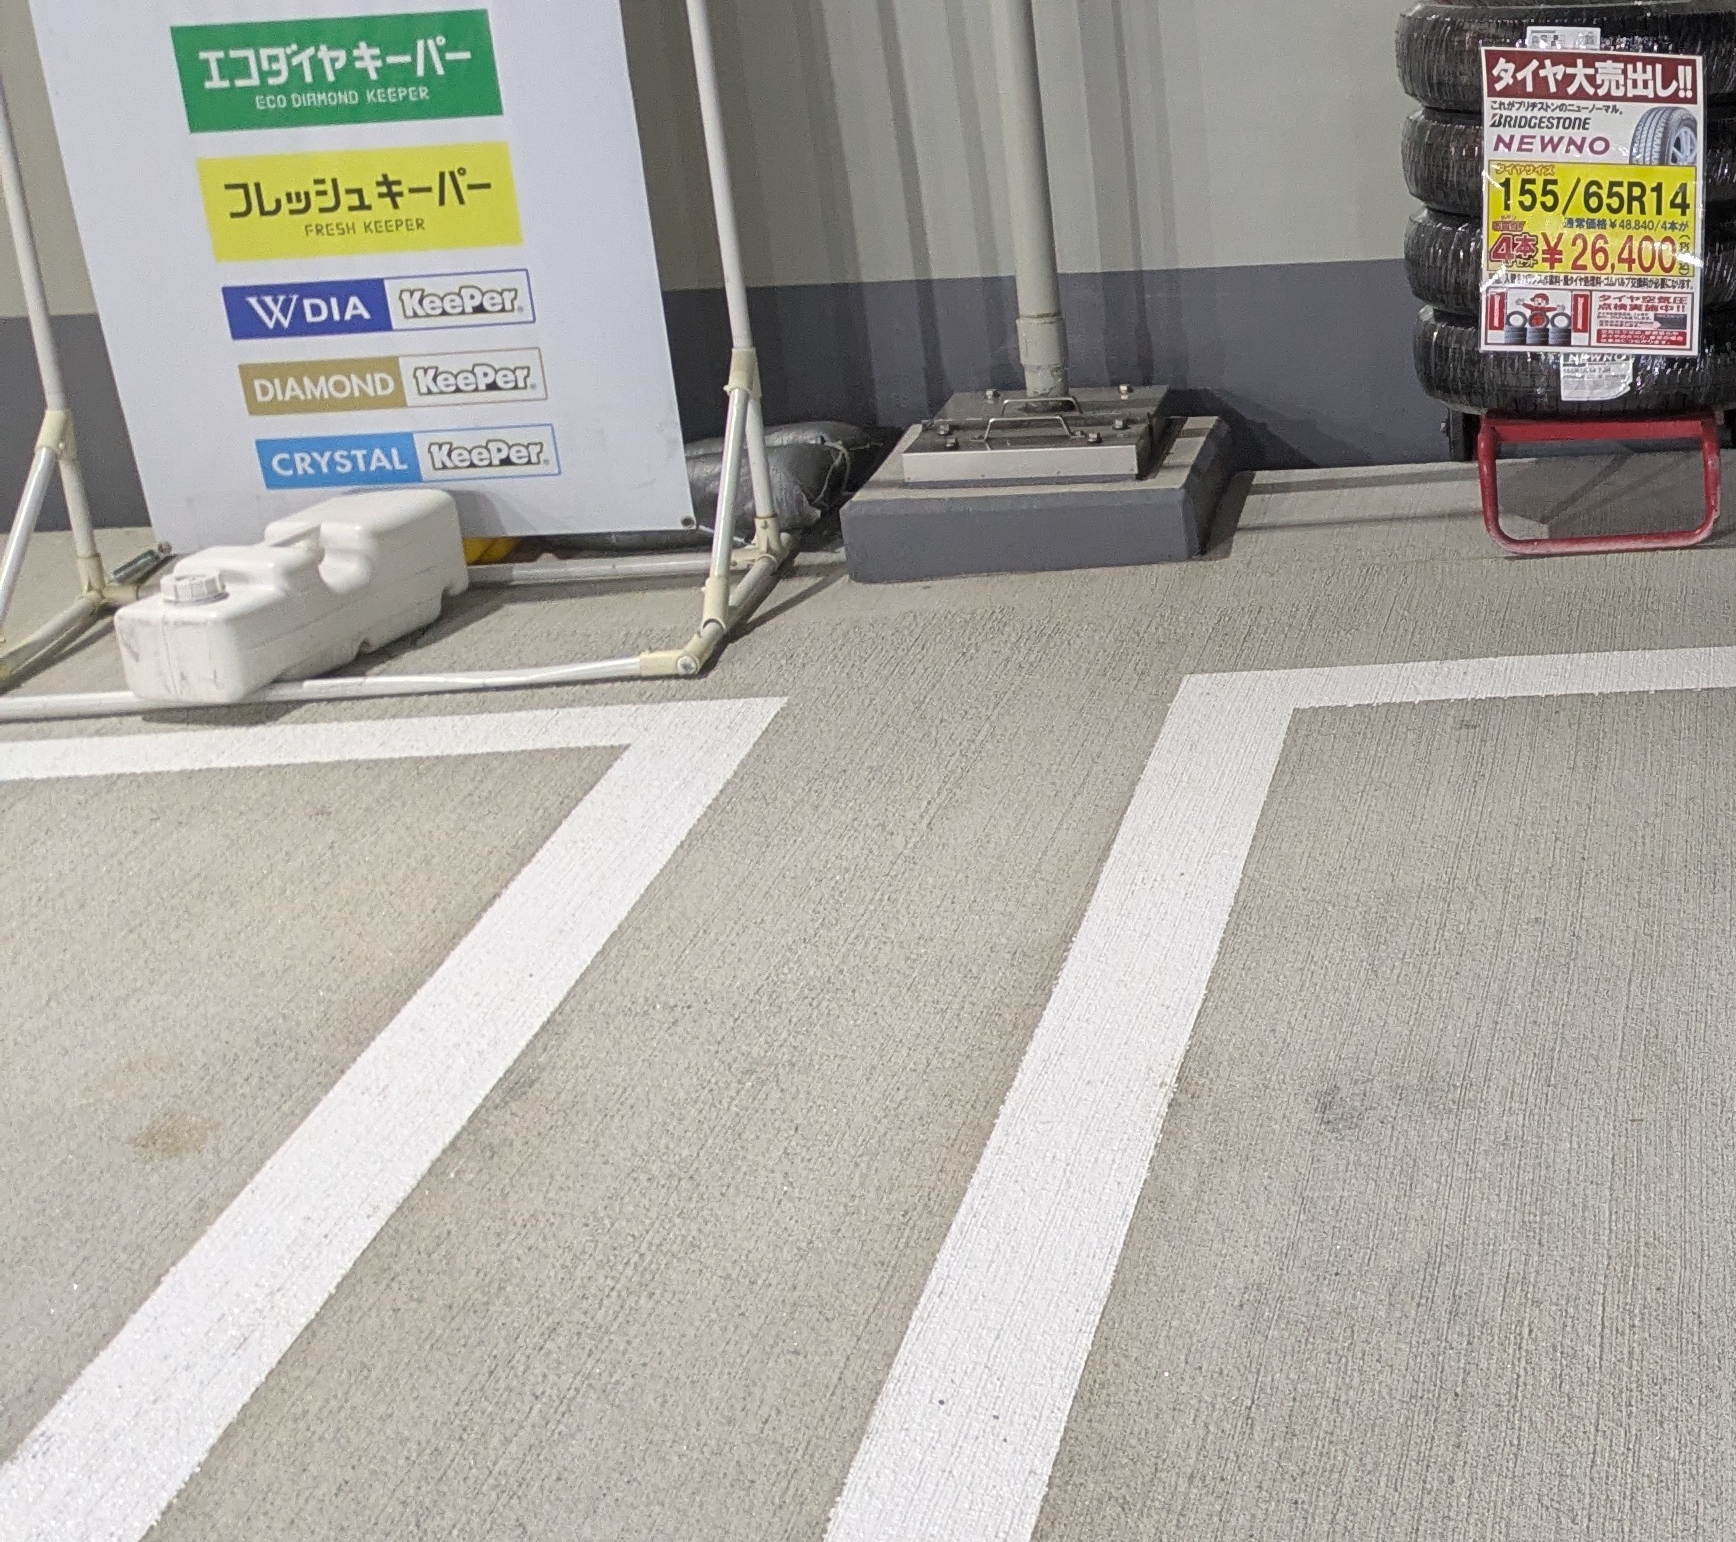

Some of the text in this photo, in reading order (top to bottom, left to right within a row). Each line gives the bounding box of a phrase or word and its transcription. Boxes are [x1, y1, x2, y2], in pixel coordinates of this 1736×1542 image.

[201, 33, 473, 92] エコダイヤキーパー
[1491, 56, 1693, 99] タイヤ大売出し!!
[255, 84, 431, 110] ECO DIAMOND KEEPER
[1489, 112, 1591, 131] BRIDGESTONE
[1493, 133, 1611, 156] NEWNO
[223, 166, 494, 220] フレッシュキーパー
[1499, 176, 1691, 217] 155/65R14
[304, 216, 427, 239] FRESH KEEPER
[1490, 232, 1538, 262] 4本
[1541, 231, 1678, 275] ¥26,400
[400, 285, 519, 320] KeePer
[253, 363, 531, 404] DIAMOND KeePer
[271, 440, 545, 477] CRYSTAL KeePer
